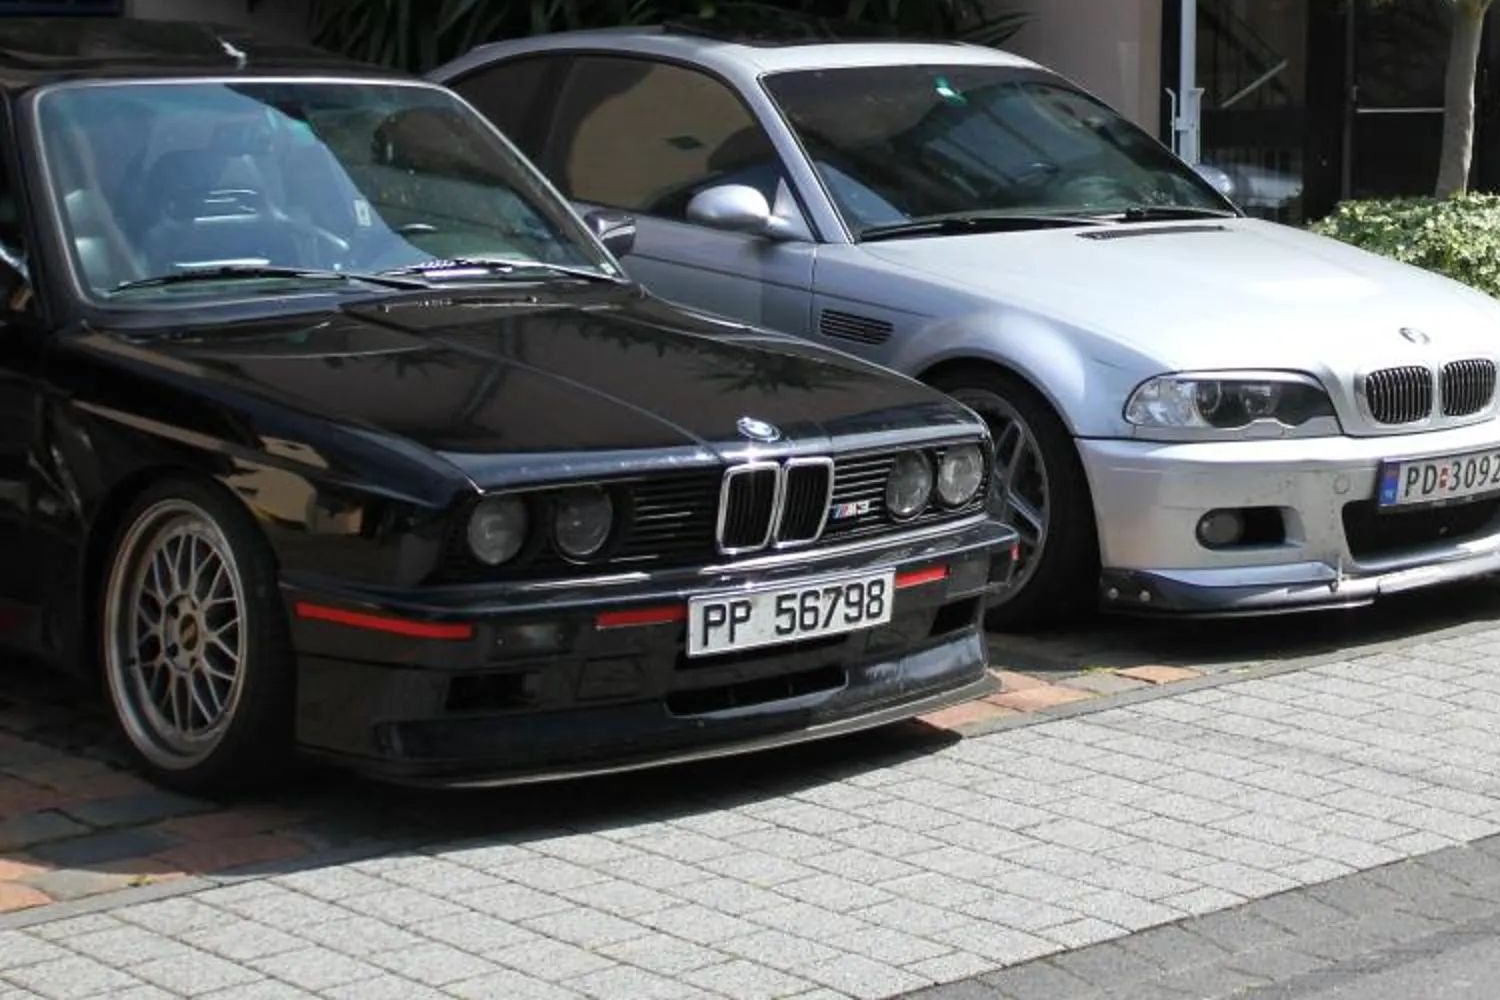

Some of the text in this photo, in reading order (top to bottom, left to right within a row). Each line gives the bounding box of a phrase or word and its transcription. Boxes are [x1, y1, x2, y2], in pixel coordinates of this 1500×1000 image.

[1405, 464, 1438, 497] PD
[703, 578, 885, 646] PP 56798
